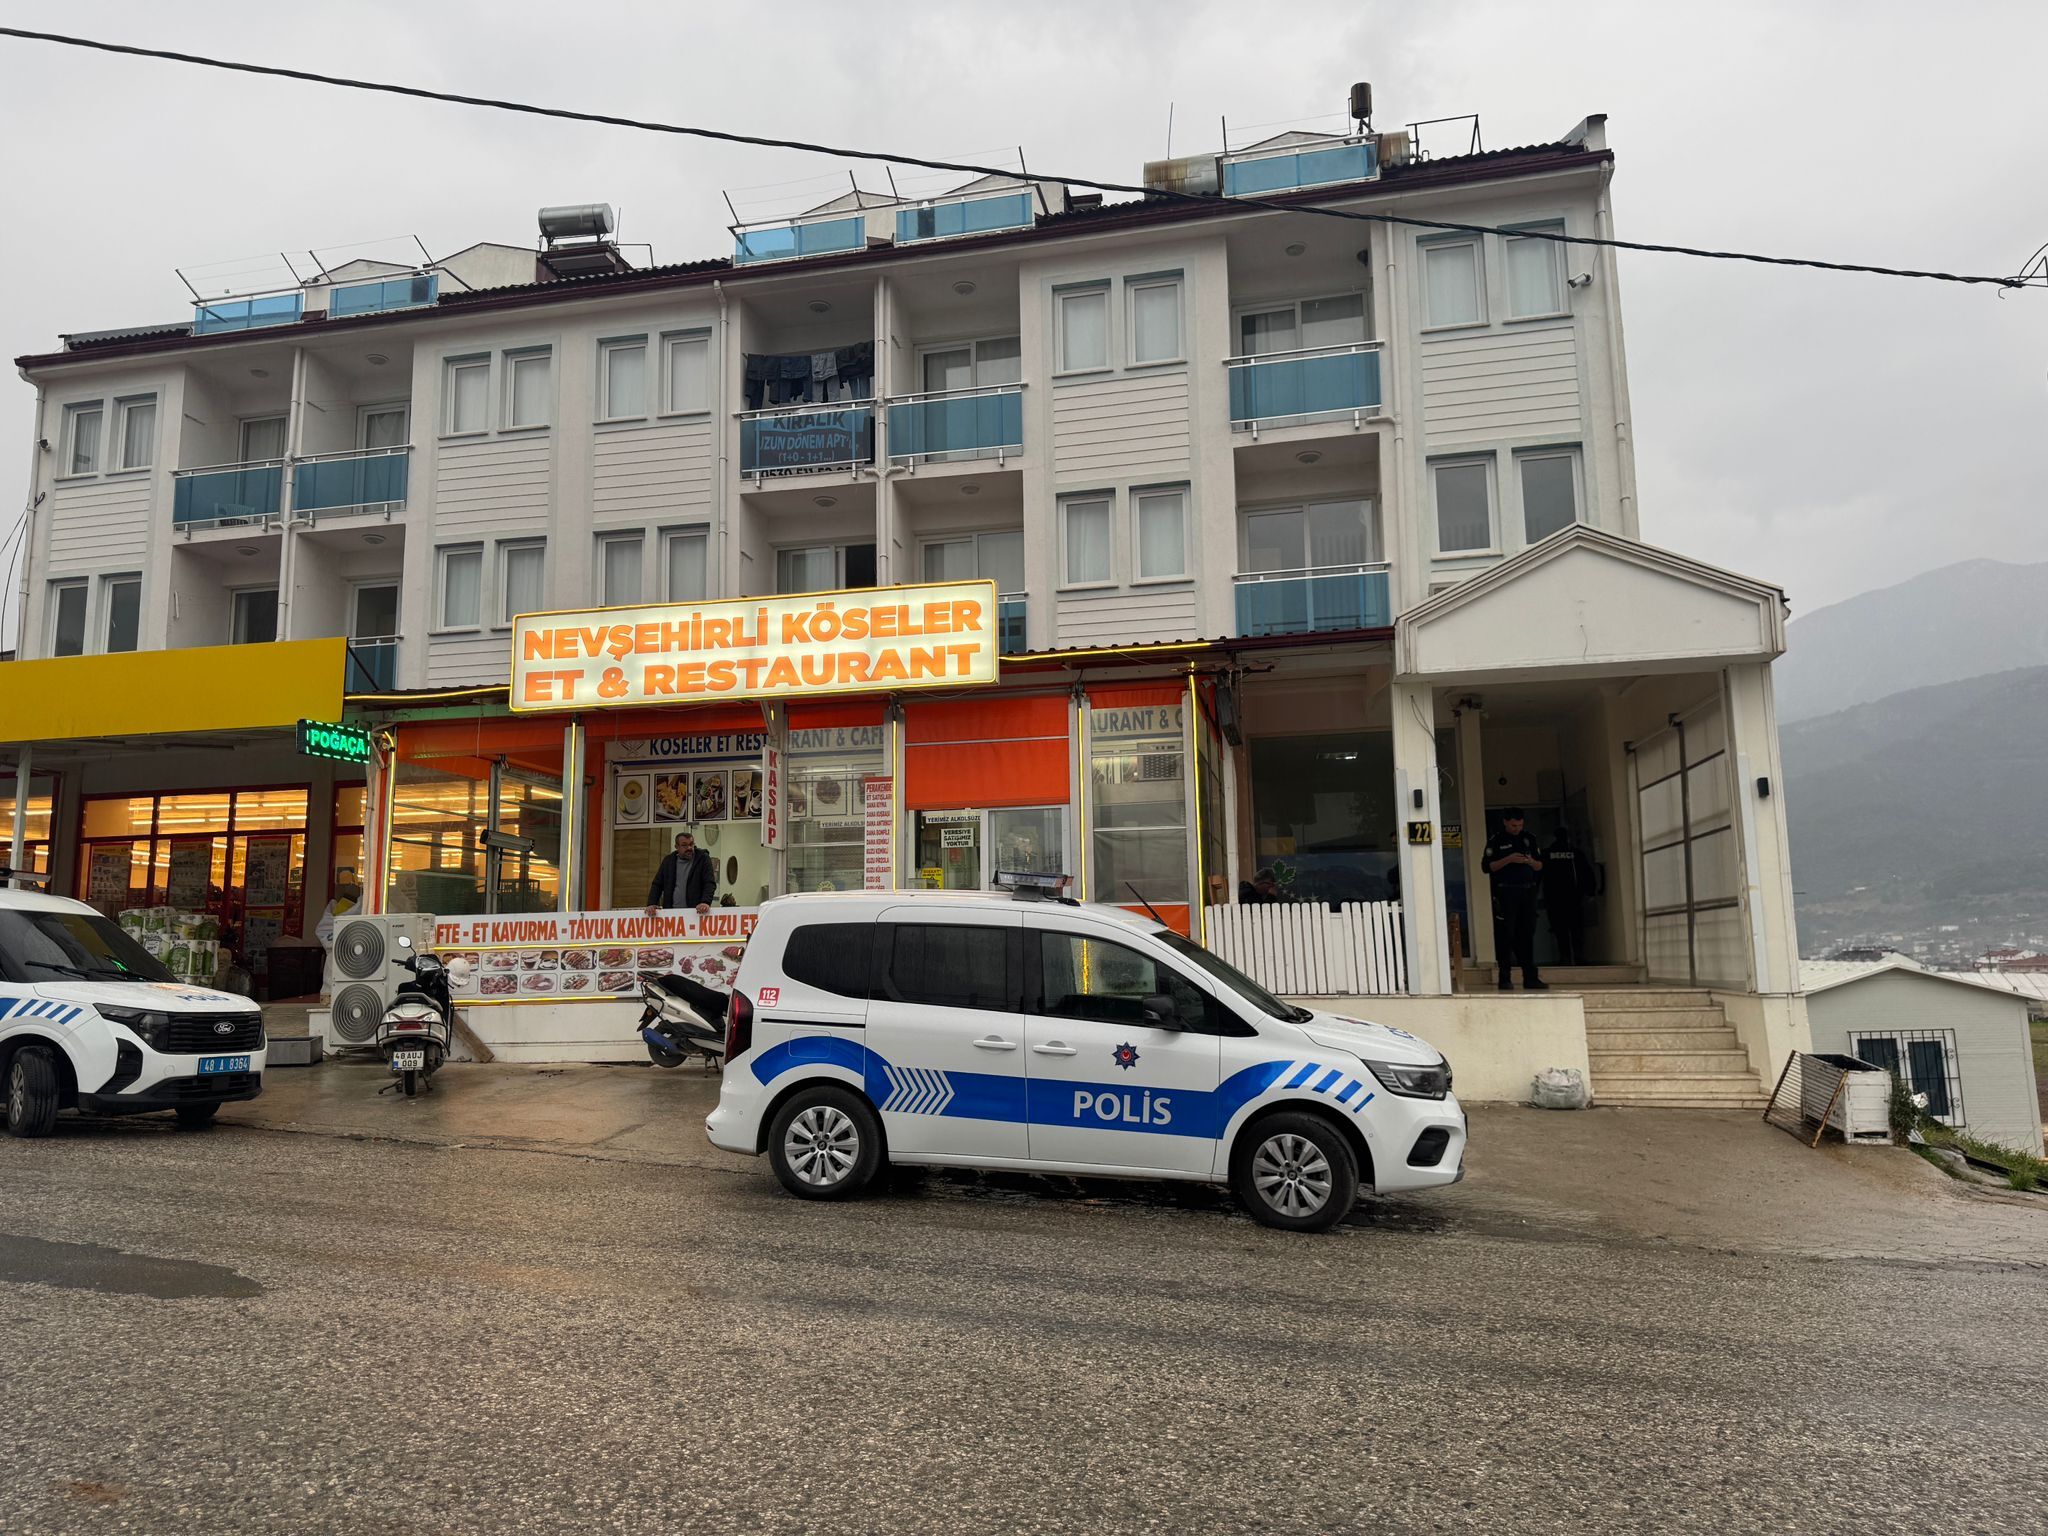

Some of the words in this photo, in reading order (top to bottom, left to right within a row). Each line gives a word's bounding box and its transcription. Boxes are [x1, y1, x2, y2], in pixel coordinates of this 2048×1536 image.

[787, 433, 824, 450] DÖNEM
[524, 607, 768, 662] NEVŞEHİRLİ
[782, 600, 983, 644] KÖSELER
[524, 669, 584, 702] ET
[597, 666, 630, 699] &
[644, 643, 980, 696] RESTAURANT
[1159, 709, 1169, 730] &
[310, 728, 366, 756] POĞAÇA
[717, 735, 731, 753] ET
[767, 749, 778, 845] KASAP
[866, 783, 893, 792] PERAKENDE
[1415, 823, 1430, 842] 22
[436, 923, 460, 944] FTE
[472, 922, 488, 943] ET
[491, 920, 557, 942] KAVURMA
[569, 918, 613, 940] TAVUK
[617, 916, 686, 939] KAVURMA
[699, 914, 736, 937] KUZU
[740, 913, 758, 935] ET
[762, 989, 777, 1000] 112
[204, 1059, 215, 1072] 48
[219, 1059, 224, 1071] A
[229, 1057, 248, 1070] 8364
[395, 1052, 406, 1060] 48
[1073, 1090, 1172, 1125] POLİS
